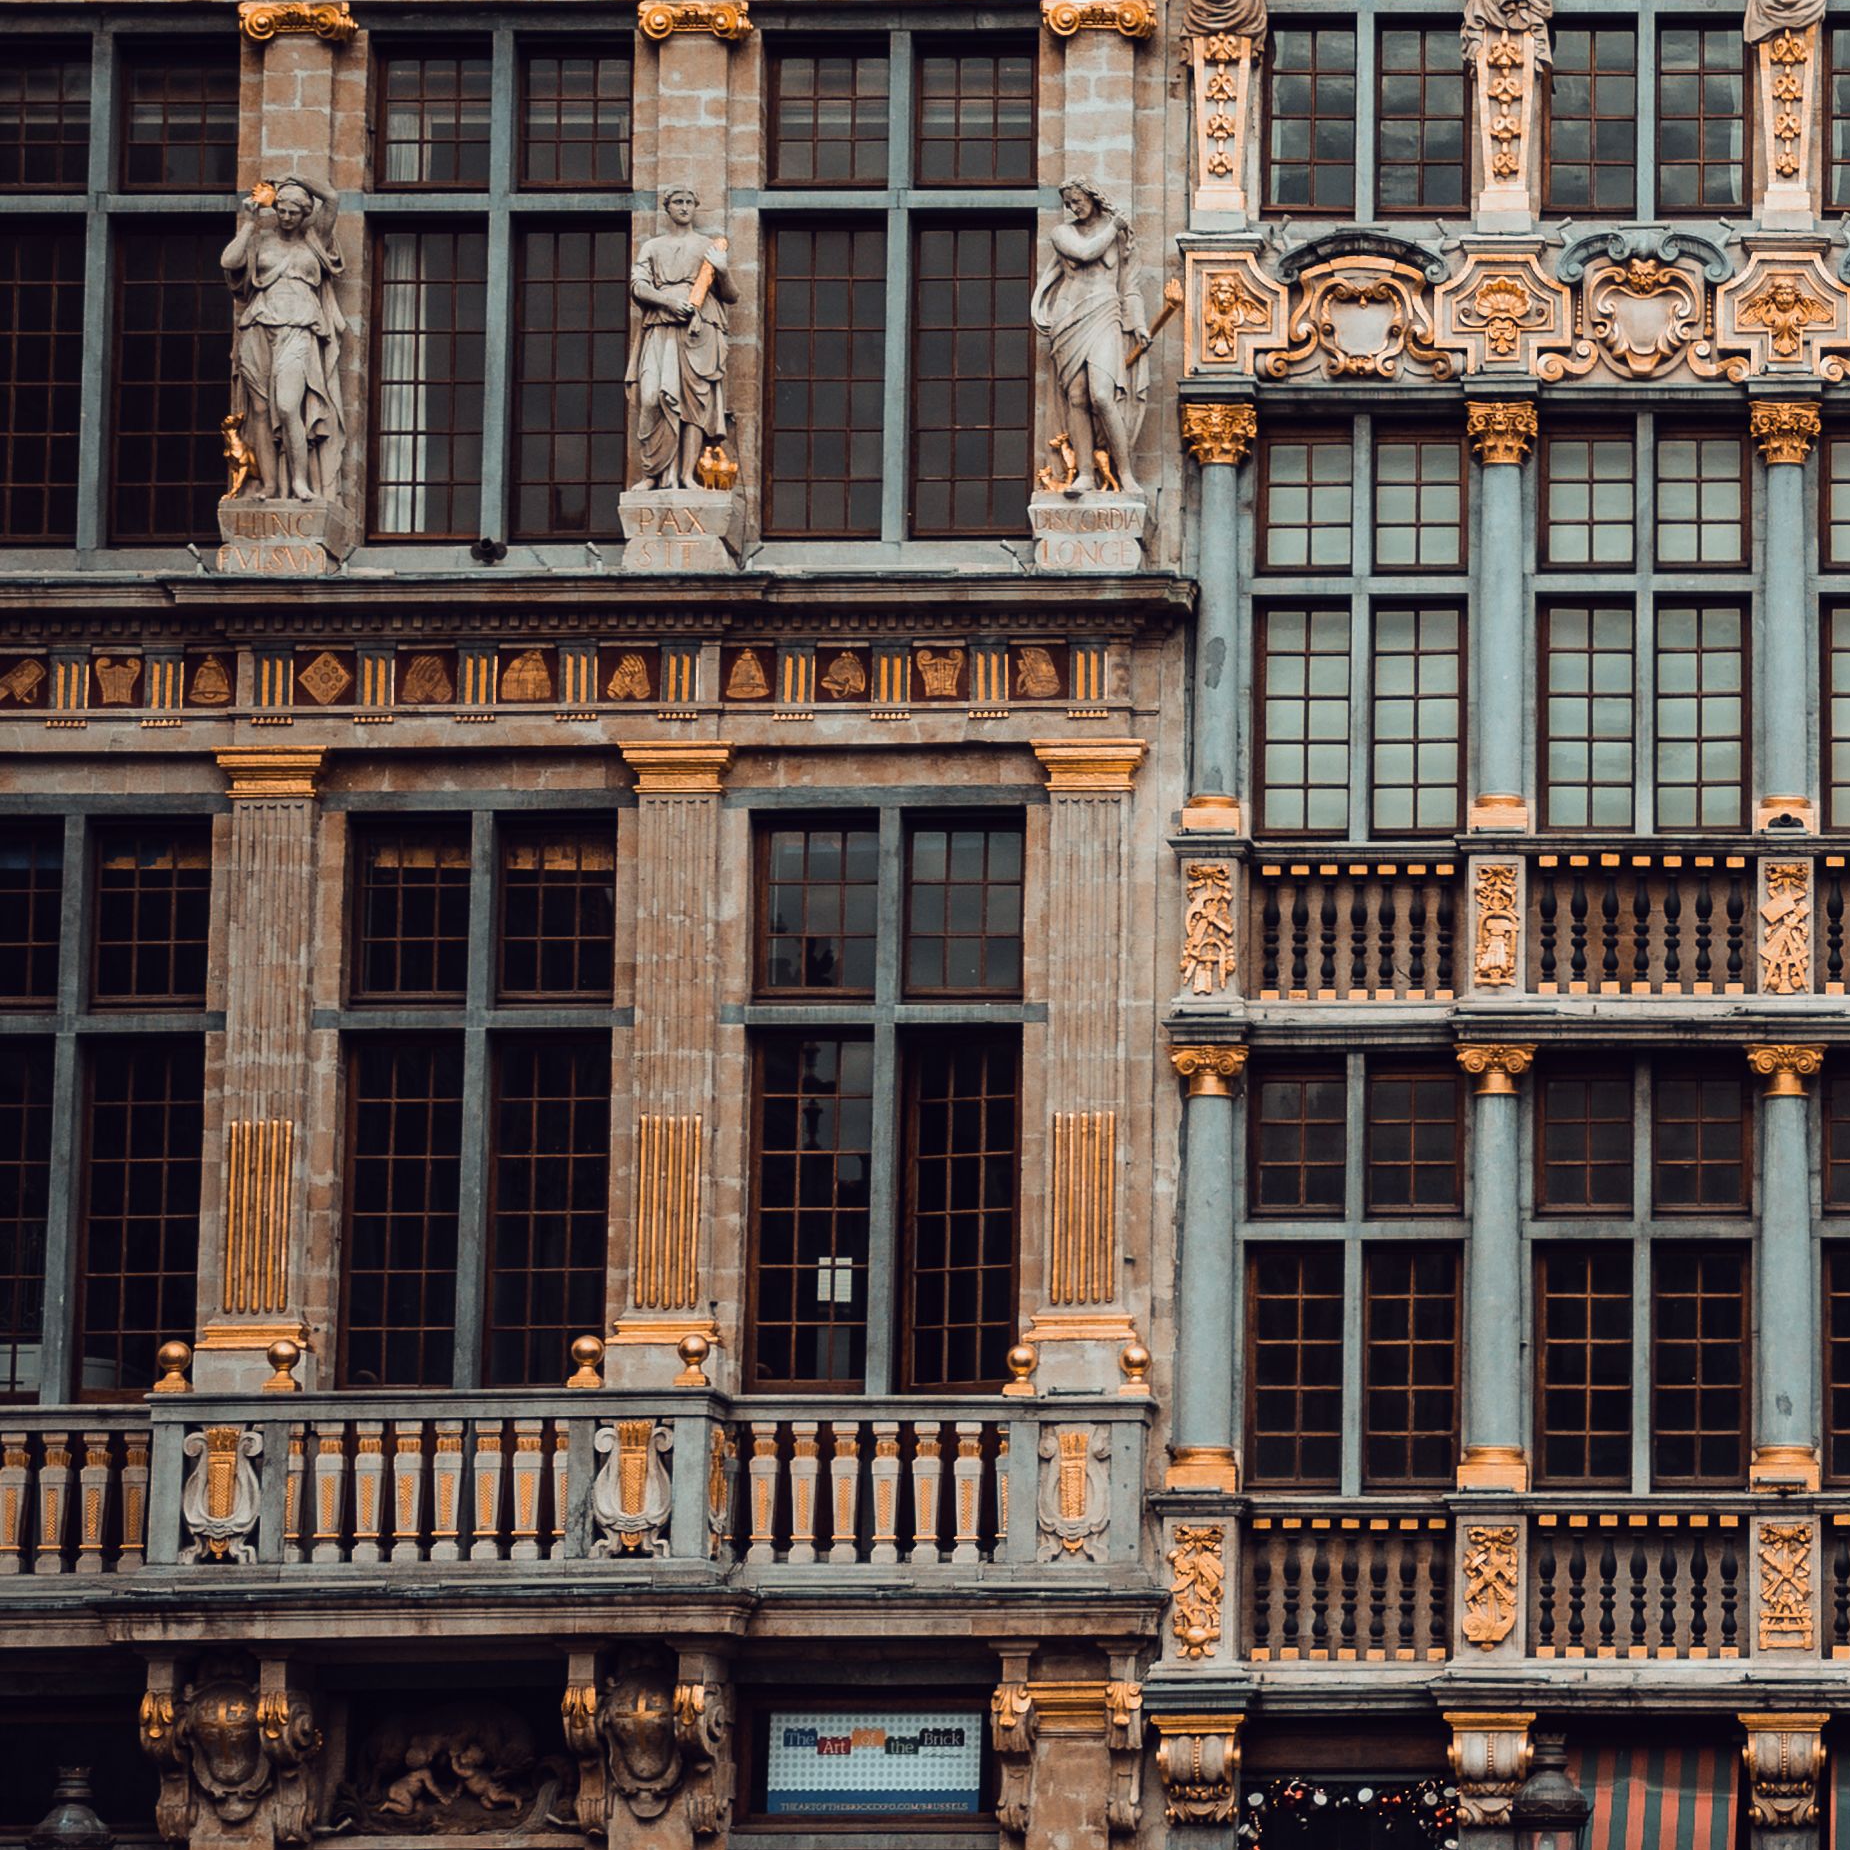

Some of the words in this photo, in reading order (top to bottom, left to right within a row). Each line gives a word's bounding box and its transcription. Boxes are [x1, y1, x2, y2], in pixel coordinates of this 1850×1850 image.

[235, 511, 313, 539] HINC
[636, 506, 708, 536] PAX
[1034, 507, 1143, 530] DISCORDIA
[634, 539, 702, 569] SIT
[1041, 539, 1135, 568] LONGE
[785, 1732, 815, 1746] The
[822, 1741, 846, 1754] Art
[860, 1731, 876, 1745] of
[890, 1741, 914, 1754] the
[923, 1732, 960, 1746] Brick
